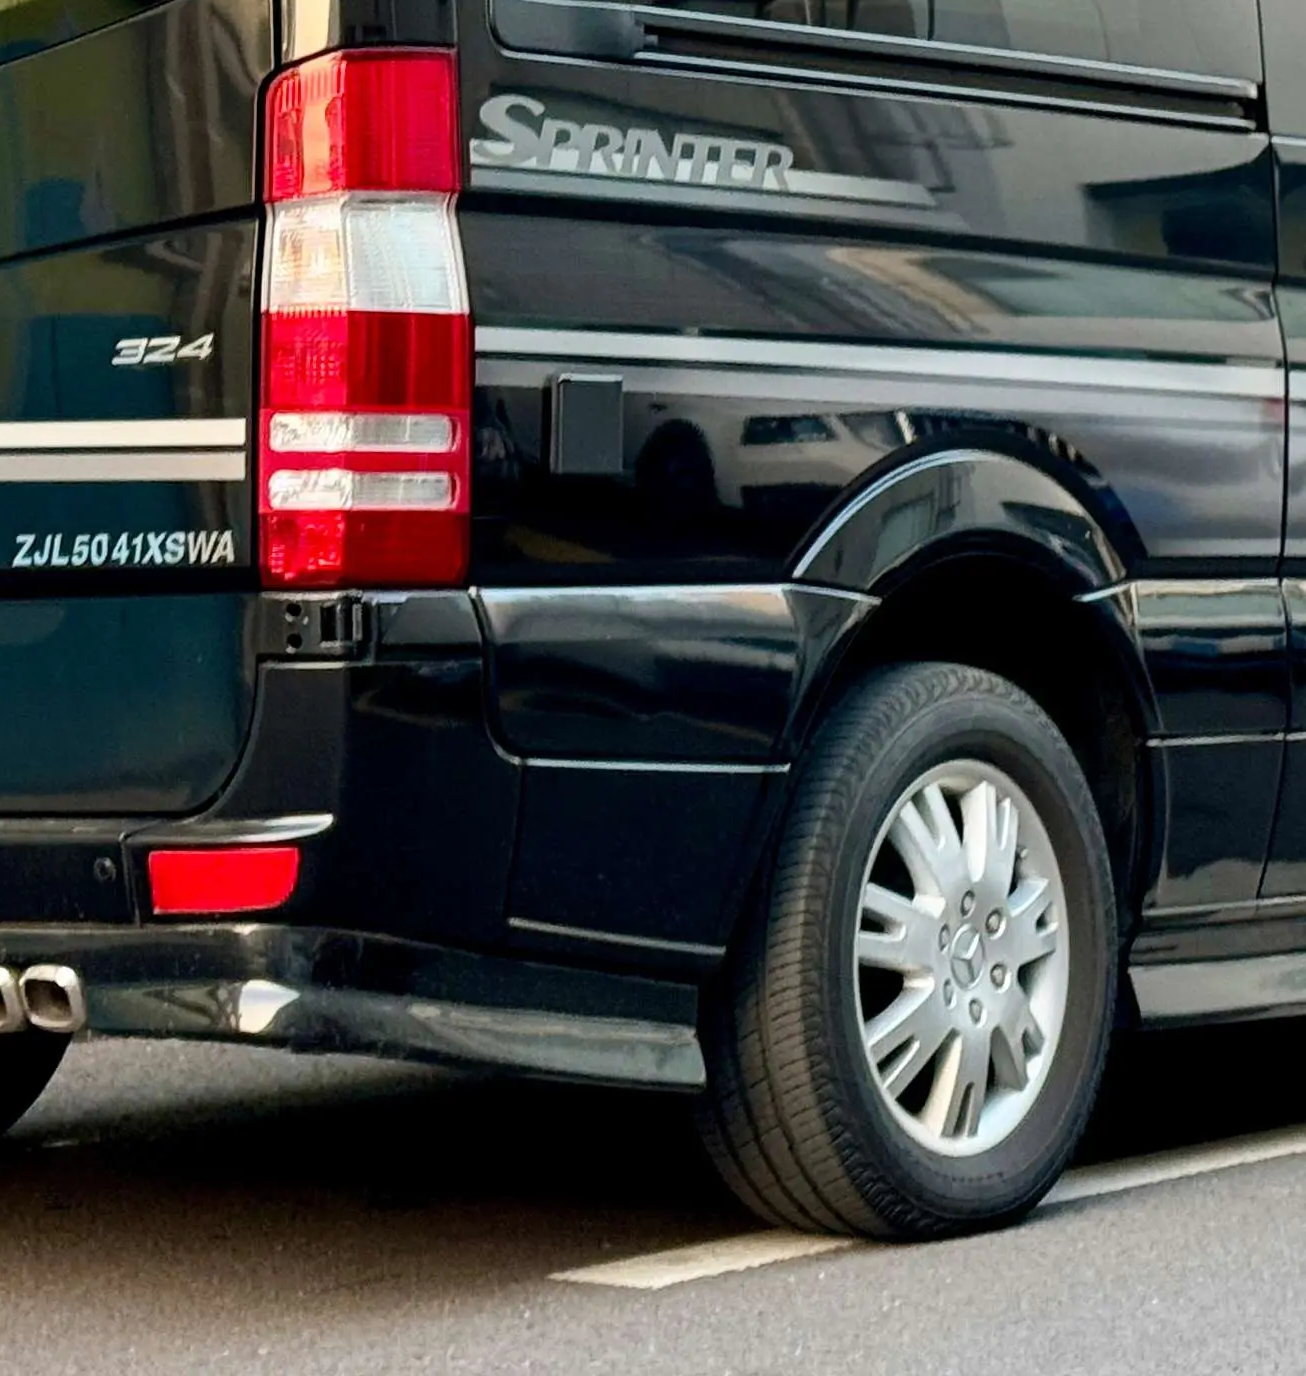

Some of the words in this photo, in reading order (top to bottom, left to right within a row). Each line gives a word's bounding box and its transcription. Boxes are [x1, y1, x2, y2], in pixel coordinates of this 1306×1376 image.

[478, 93, 795, 191] SPRINTER
[111, 332, 214, 366] 324
[12, 530, 235, 568] ZJL5041XSWA
